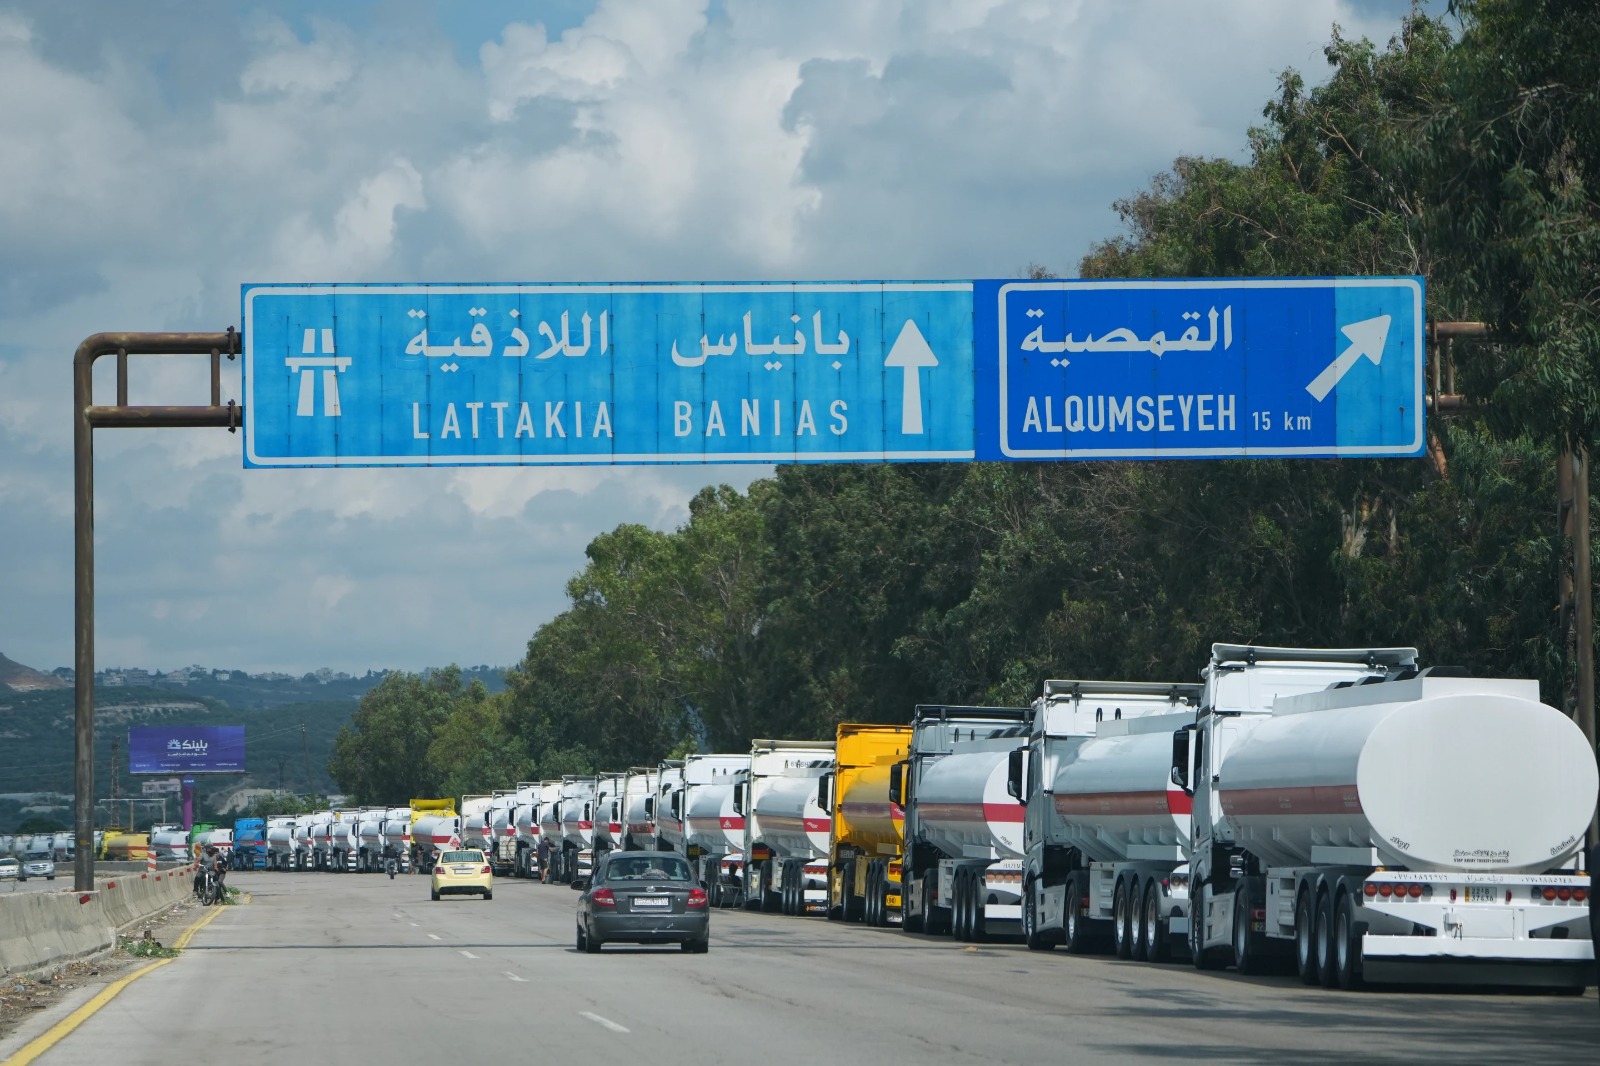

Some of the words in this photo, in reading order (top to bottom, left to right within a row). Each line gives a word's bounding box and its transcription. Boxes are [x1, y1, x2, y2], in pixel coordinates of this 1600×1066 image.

[404, 307, 608, 373] اللاذقية
[671, 309, 850, 371] بانياس
[1020, 304, 1233, 367] القمصية
[412, 401, 614, 439] LATTAKIA
[673, 398, 849, 437] BANIAS
[1022, 393, 1236, 433] ALQUMSEYEH
[1252, 411, 1271, 431] 15
[1284, 411, 1312, 431] km
